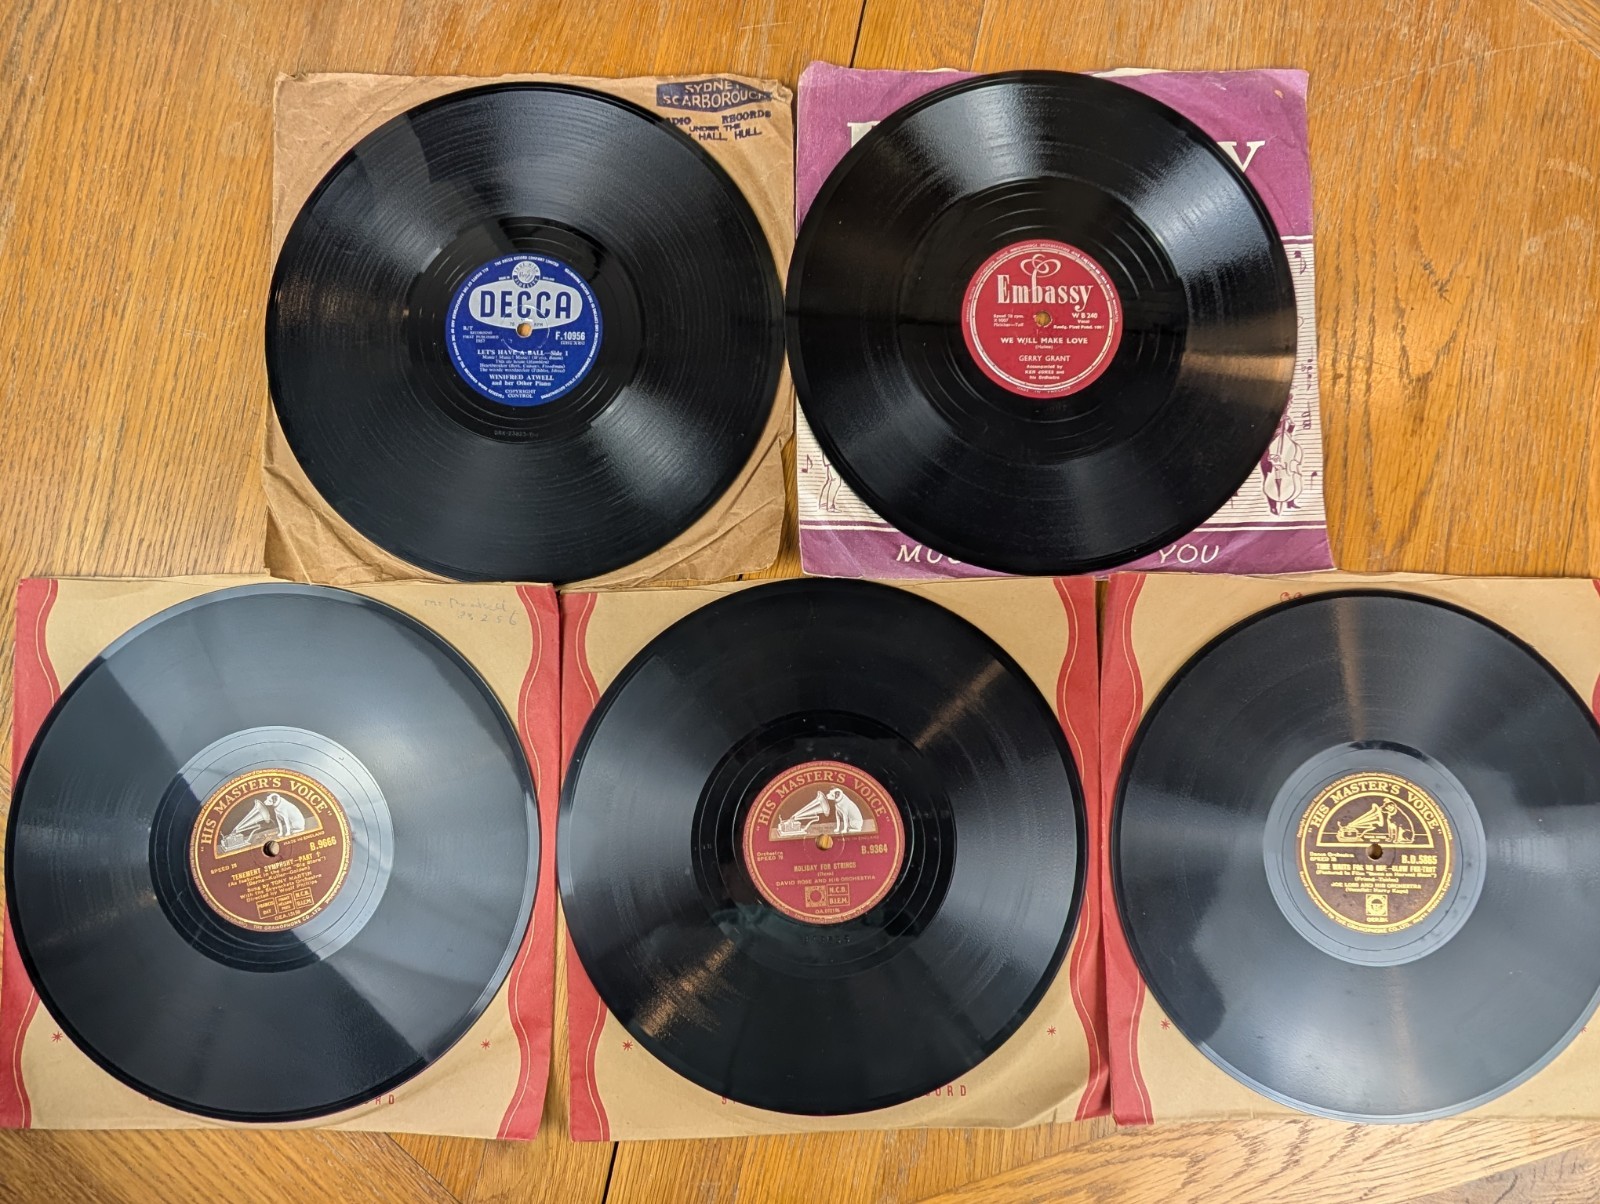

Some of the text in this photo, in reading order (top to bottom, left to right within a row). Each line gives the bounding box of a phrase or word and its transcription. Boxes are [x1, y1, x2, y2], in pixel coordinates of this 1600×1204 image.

[997, 267, 1094, 312] Embassy
[480, 290, 572, 319] DECCA
[555, 331, 586, 341] F.10956
[1159, 544, 1221, 564] YOU
[775, 770, 846, 799] MASTER'S
[1329, 780, 1401, 804] MASTER'S
[213, 777, 282, 816] MASTER'S
[309, 835, 337, 852] B.9666
[861, 843, 888, 855] B.9364
[231, 867, 261, 880] TENEMENT
[793, 861, 857, 873] HOLIDAY FOR STRINGS
[270, 877, 287, 886] TONY
[288, 870, 312, 881] MARTIN
